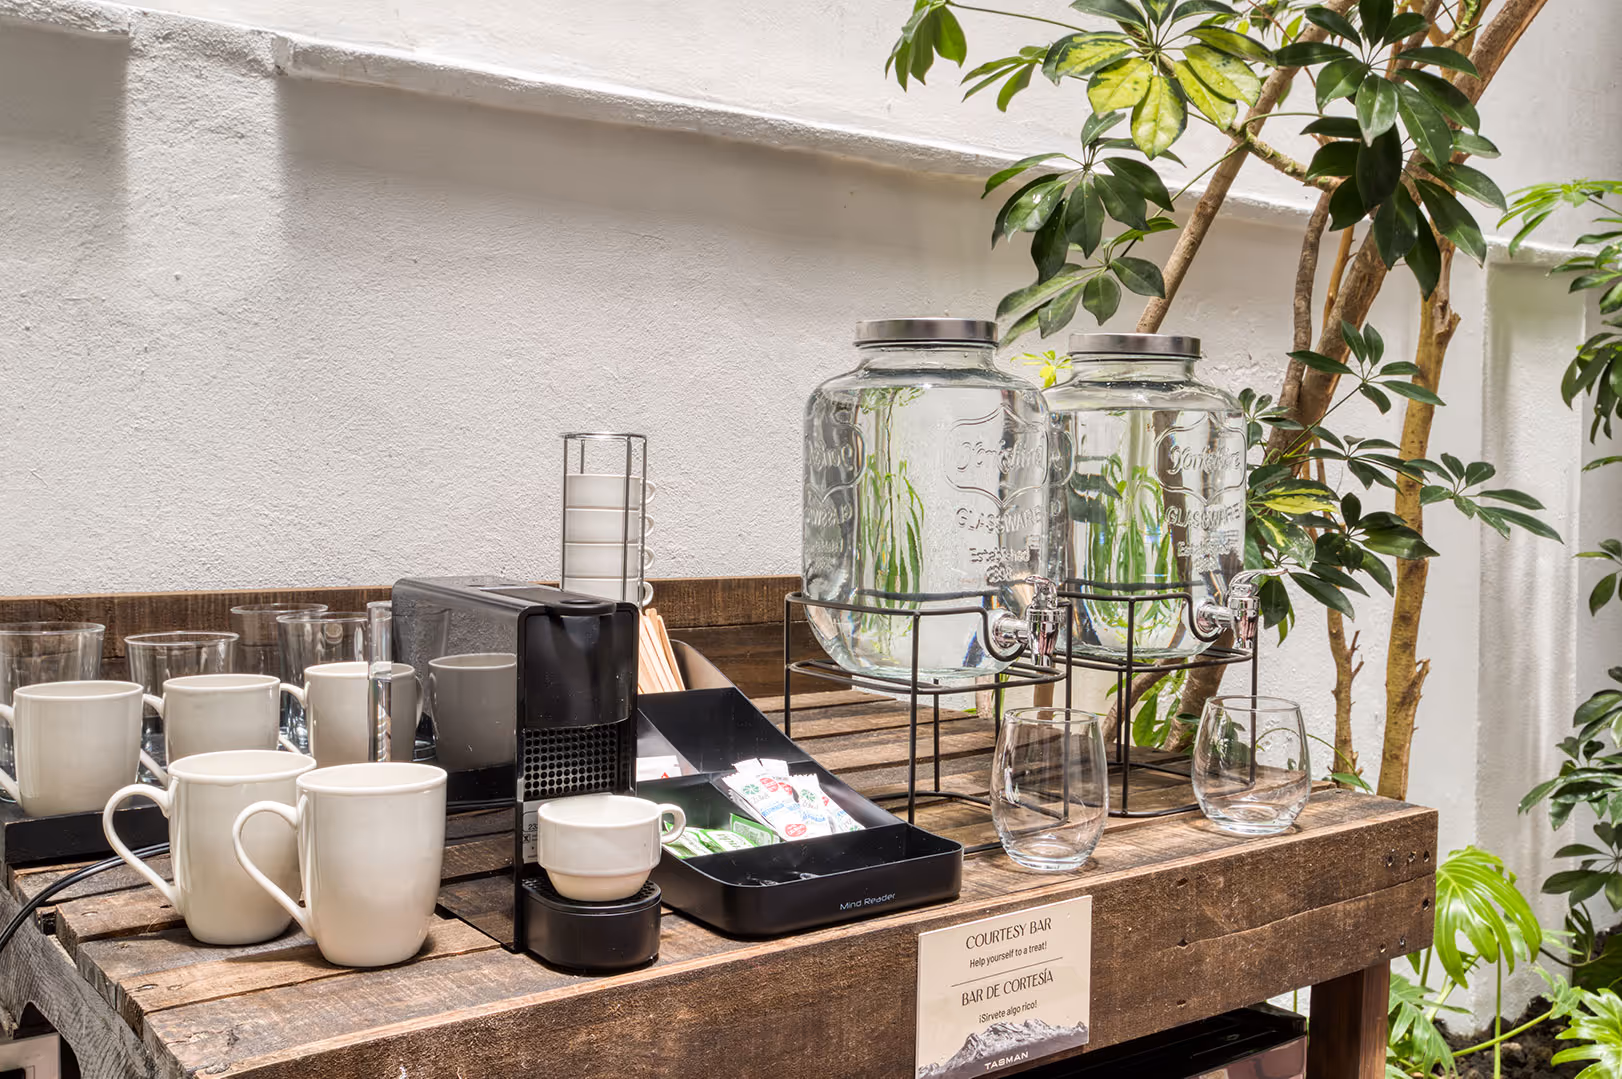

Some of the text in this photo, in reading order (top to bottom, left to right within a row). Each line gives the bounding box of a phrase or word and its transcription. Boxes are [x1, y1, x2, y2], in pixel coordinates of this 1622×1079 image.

[840, 892, 896, 910] Mind Reader
[965, 917, 1052, 950] COURTESY BAR
[969, 940, 1047, 968] Help yourself to a treat!
[961, 968, 1054, 1006] BAR DE CORTESÍA
[1006, 1005, 1021, 1017] algo
[1021, 999, 1038, 1012] rico!
[984, 1051, 1029, 1070] TASMAN
